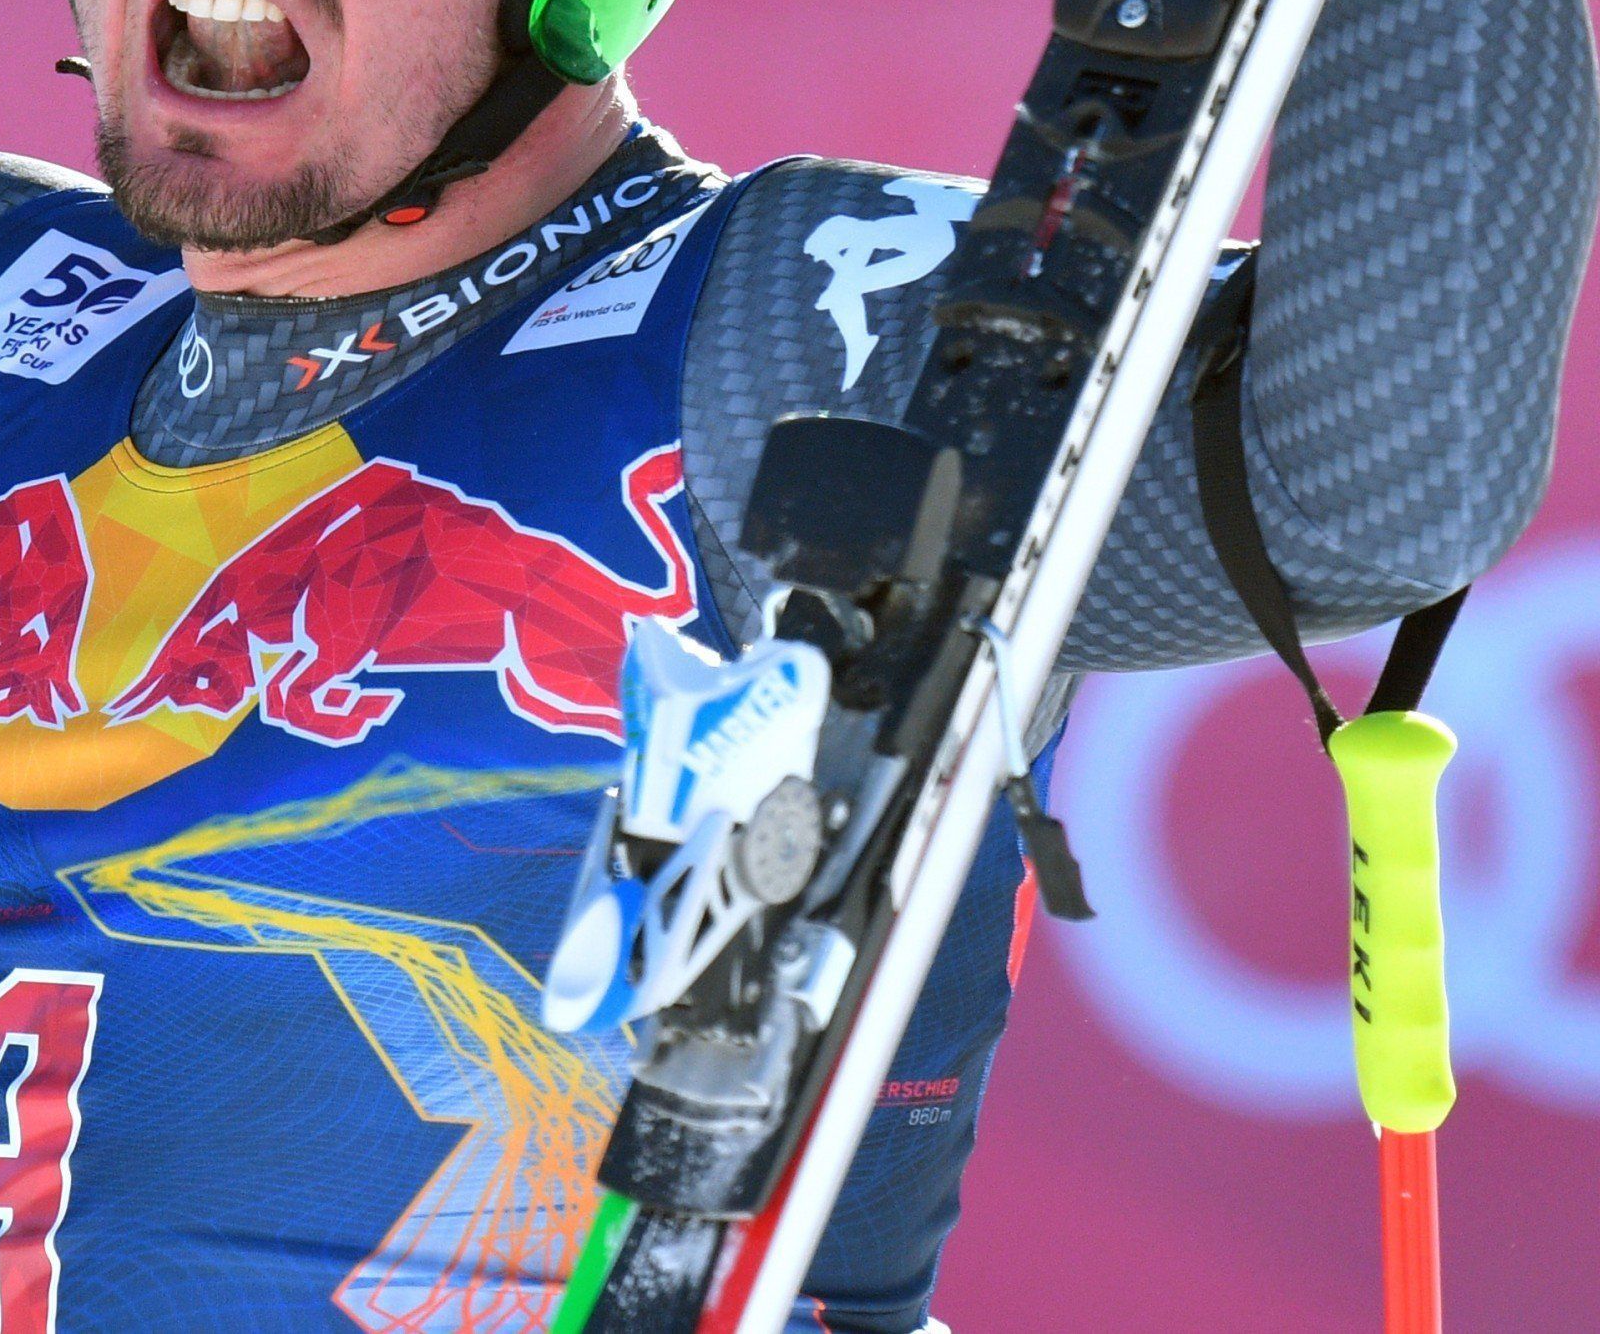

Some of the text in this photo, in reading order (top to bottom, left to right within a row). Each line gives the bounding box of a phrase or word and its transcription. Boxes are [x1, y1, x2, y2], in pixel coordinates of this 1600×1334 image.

[399, 174, 660, 338] BIONIC
[530, 301, 637, 328] FIS Ski World Cup
[1352, 838, 1372, 1025] LEKI
